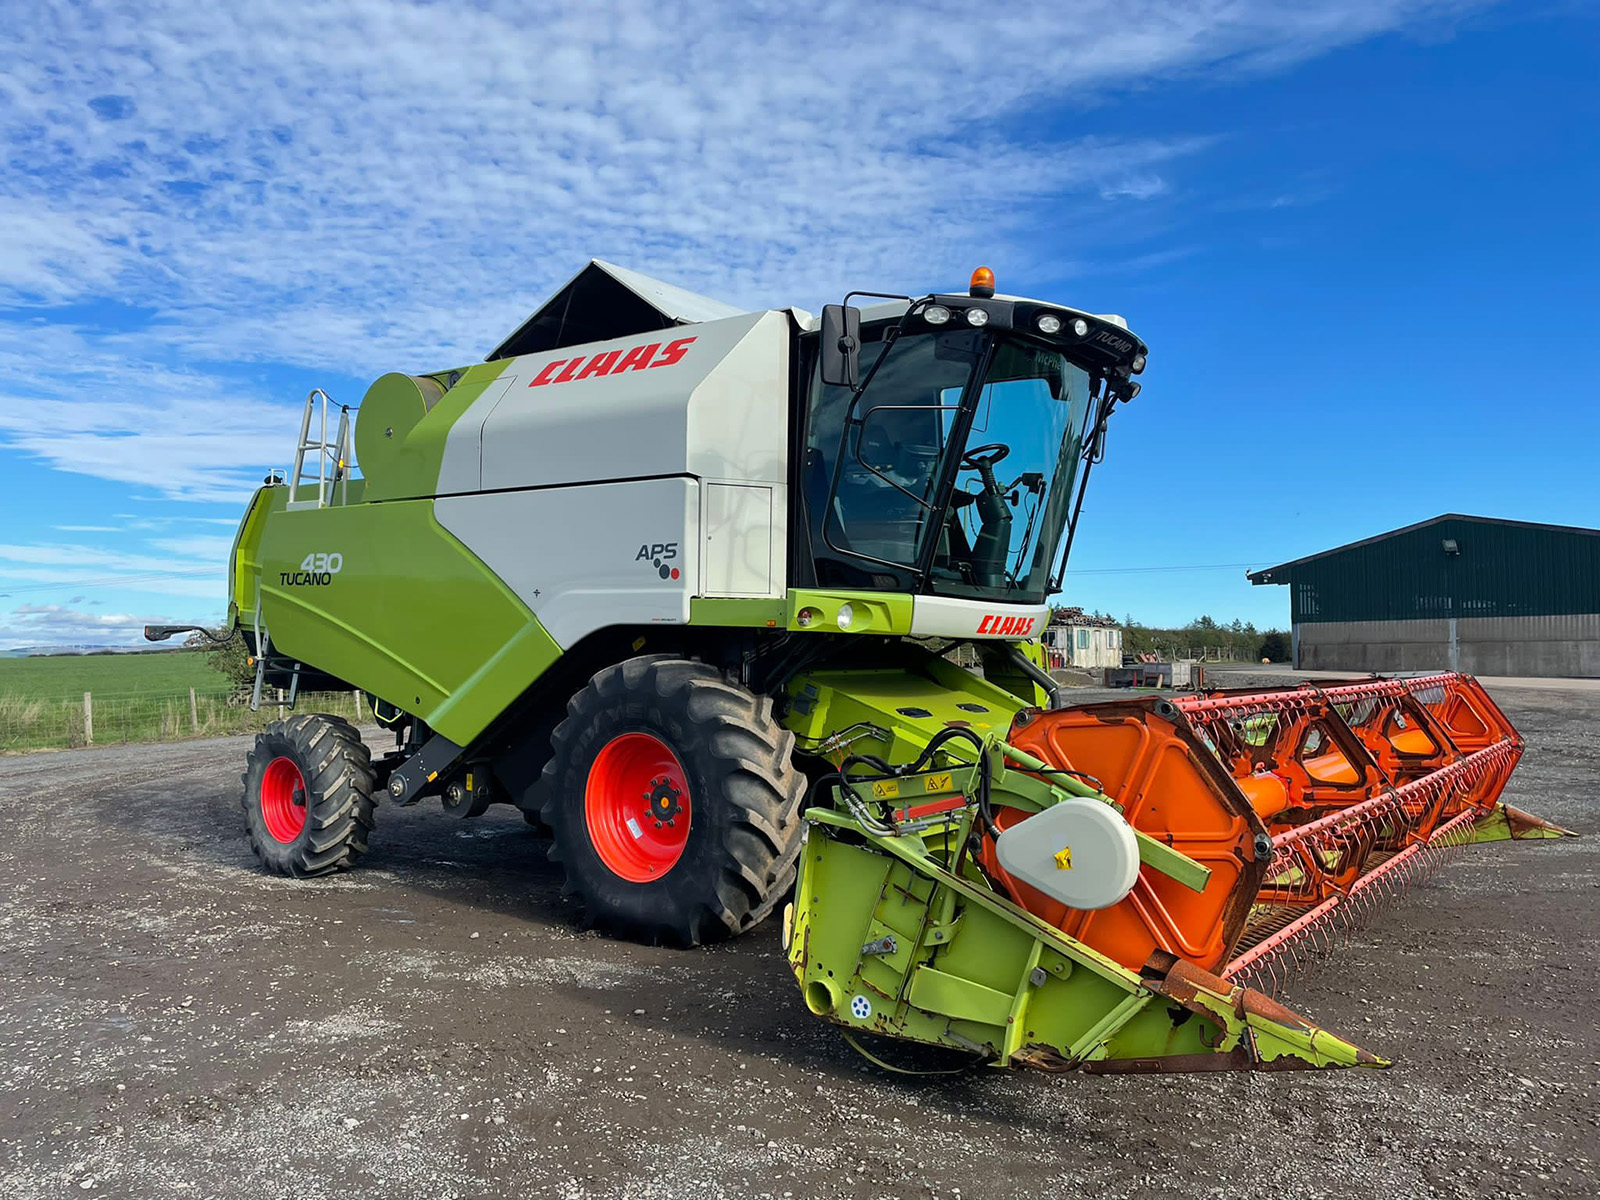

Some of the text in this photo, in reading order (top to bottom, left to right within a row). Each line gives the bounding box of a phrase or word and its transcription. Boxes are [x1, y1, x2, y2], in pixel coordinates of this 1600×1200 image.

[1096, 330, 1133, 353] TUCANO
[528, 336, 698, 387] CLAAS
[300, 552, 343, 573] 430
[635, 543, 678, 561] APS
[279, 572, 332, 586] TUCANO
[976, 614, 1035, 635] CLAAS
